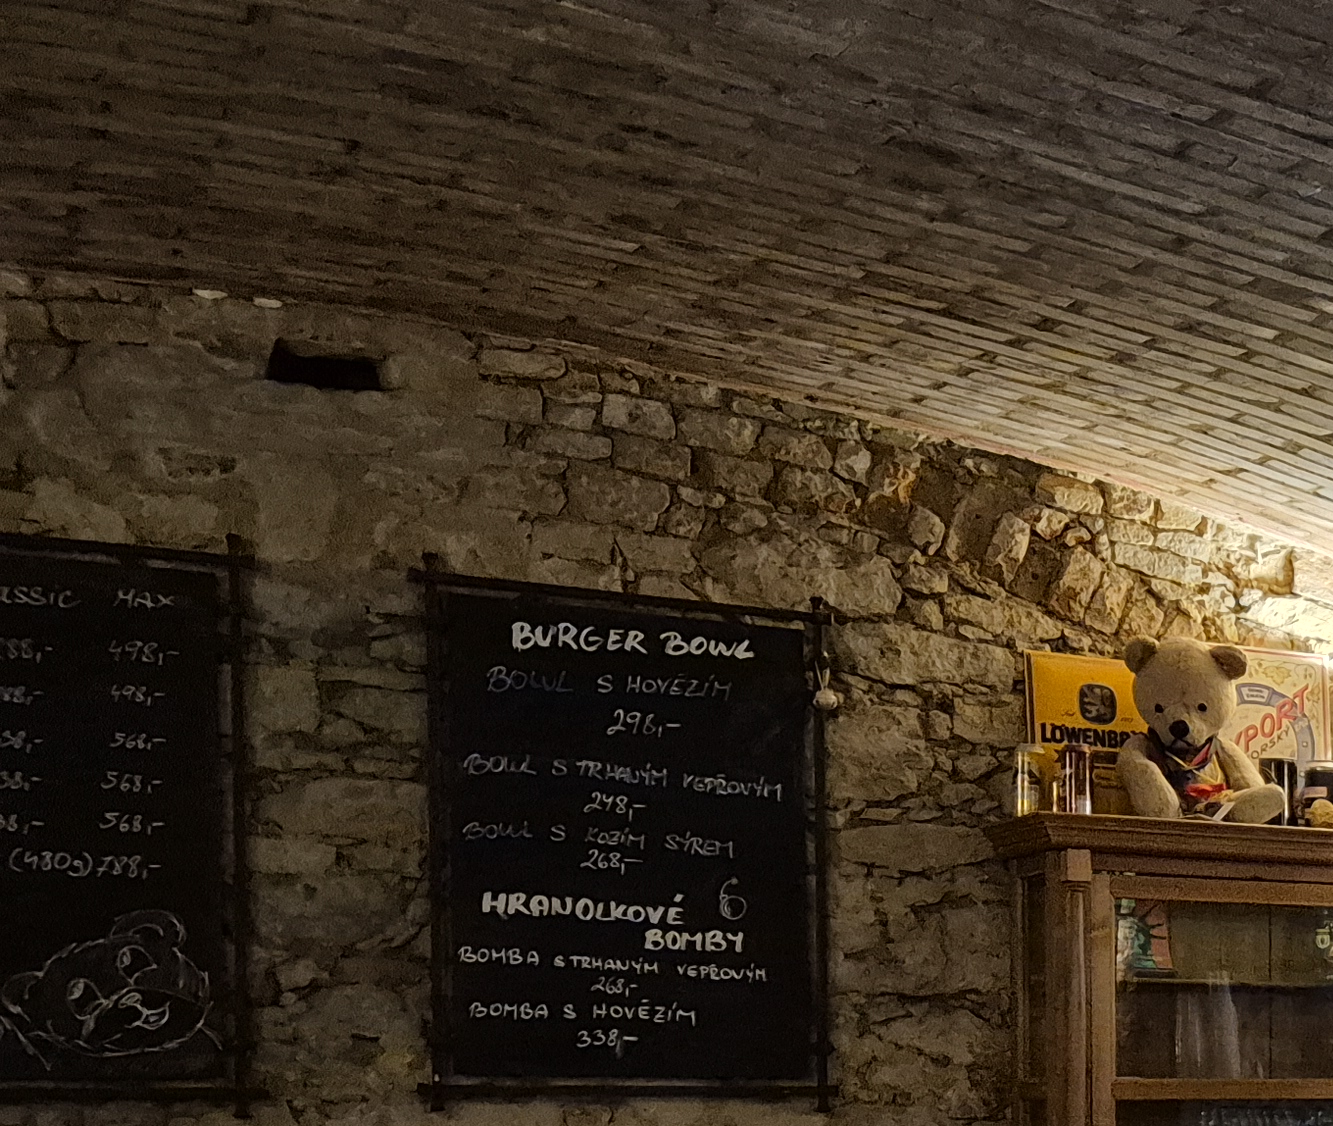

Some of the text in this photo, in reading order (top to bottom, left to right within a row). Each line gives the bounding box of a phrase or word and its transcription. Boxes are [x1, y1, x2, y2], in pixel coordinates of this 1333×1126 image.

[113, 587, 175, 611] MAX
[108, 640, 180, 666] 498,-
[511, 621, 756, 661] BURGER BOWL
[486, 665, 574, 693] BOWL
[596, 673, 614, 693] S
[605, 708, 682, 739] 298,-
[1040, 721, 1148, 750] LÖWENBR
[110, 731, 167, 751] 568,-
[462, 753, 538, 777] BOWL
[551, 758, 568, 776] S
[100, 771, 163, 794] 568,-
[582, 790, 647, 822] 248,-
[98, 811, 165, 836] 568,-
[462, 821, 534, 841] BOWL
[550, 824, 566, 842] S
[579, 848, 644, 877] 268,-
[481, 890, 686, 926] HRANOLKOVÉ
[643, 929, 745, 954] BOMBY
[457, 945, 541, 966] BOMBA
[468, 1001, 549, 1020] BOMBA
[562, 1004, 577, 1020] S
